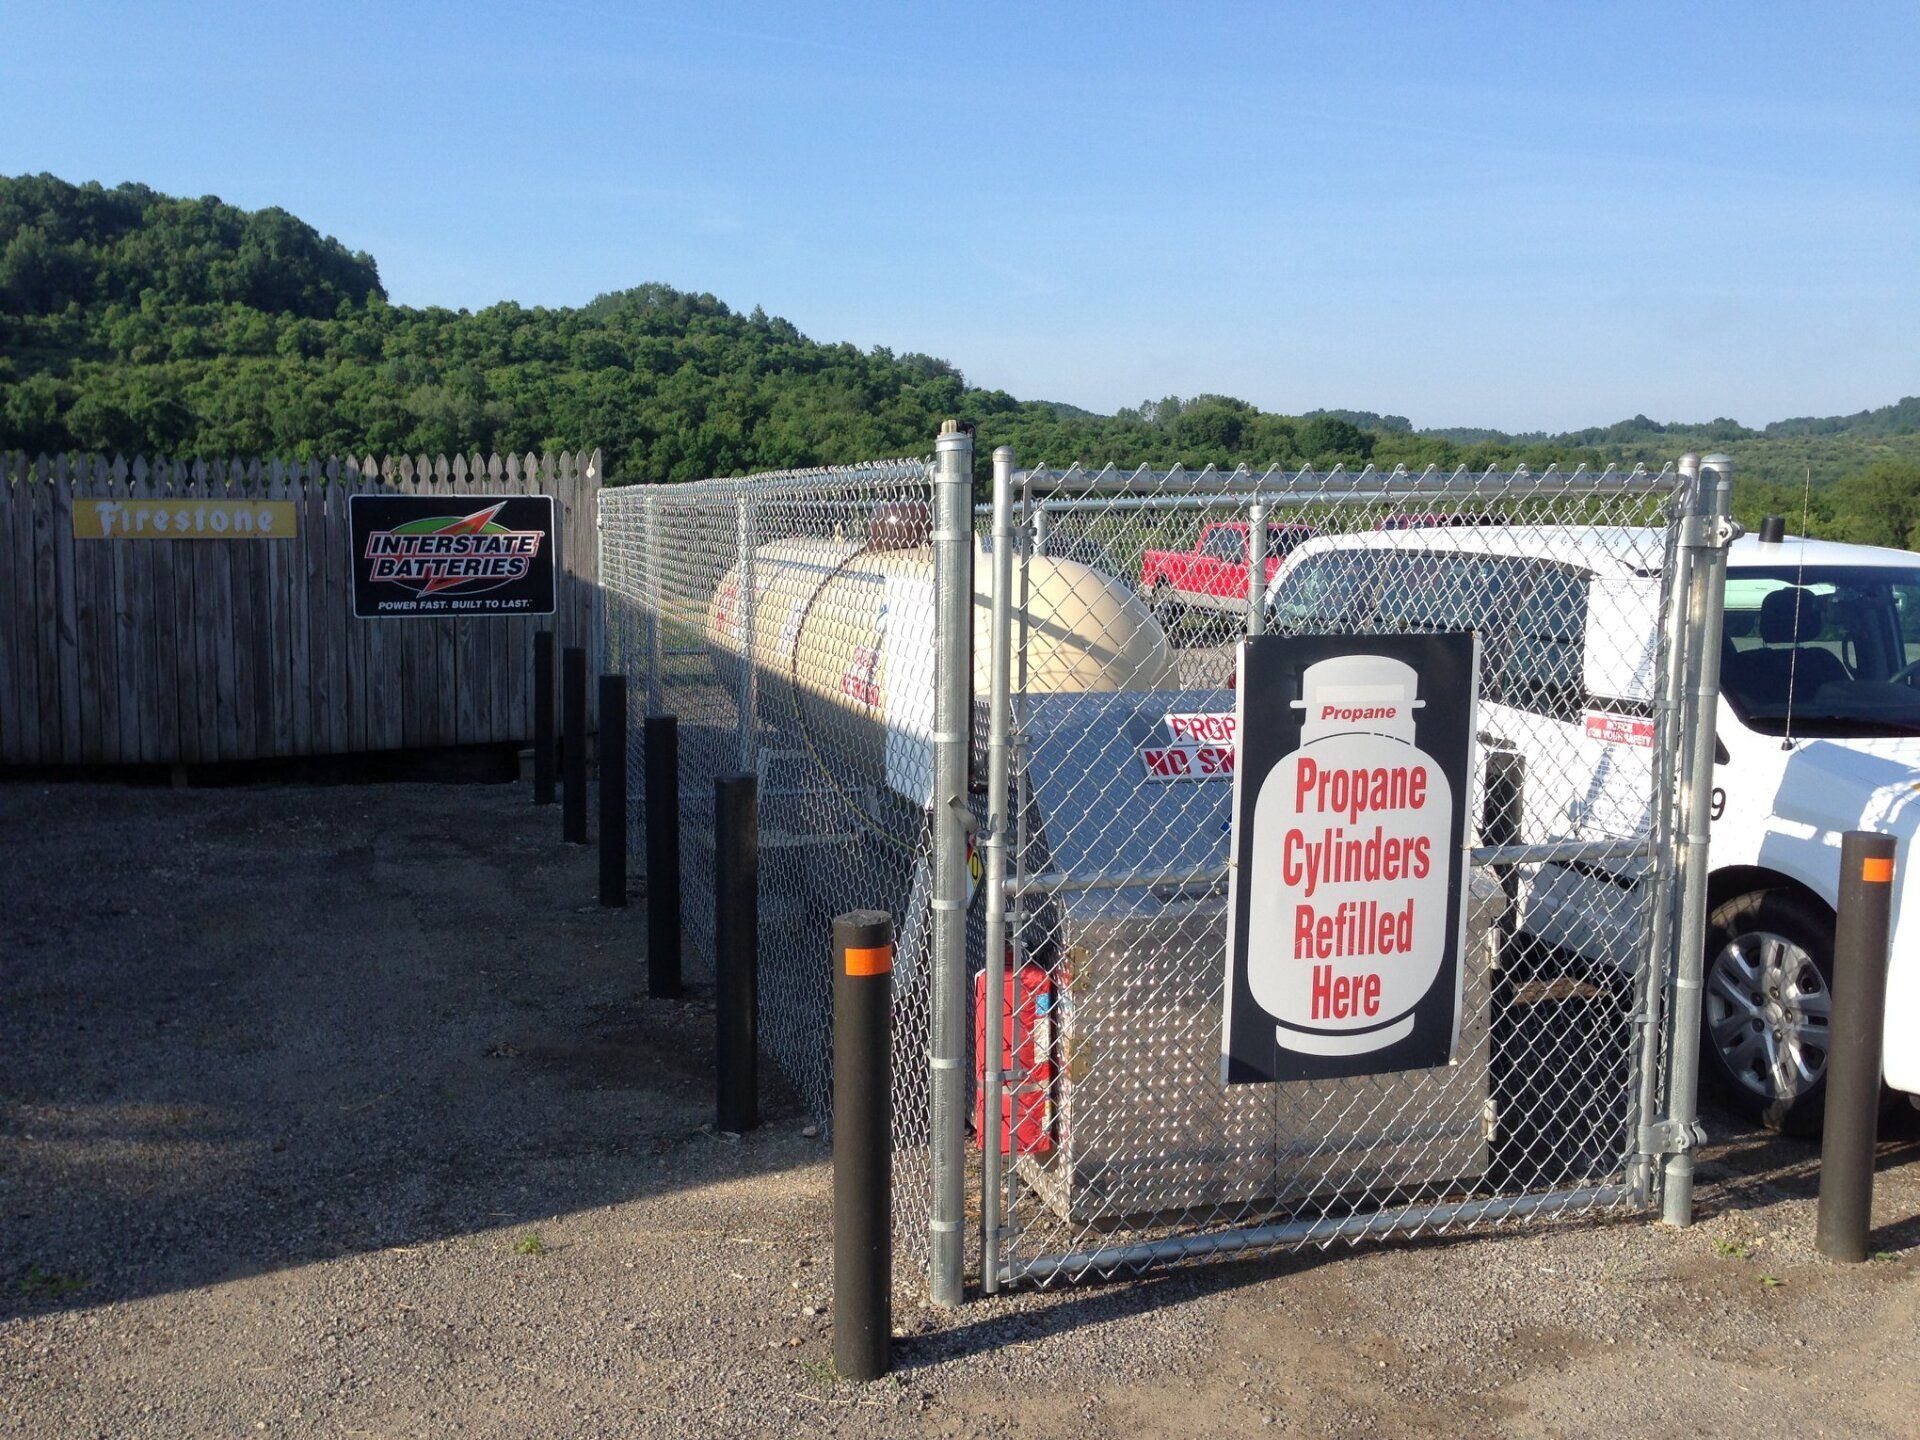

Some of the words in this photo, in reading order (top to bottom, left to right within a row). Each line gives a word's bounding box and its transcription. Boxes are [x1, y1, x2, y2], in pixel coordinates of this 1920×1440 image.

[95, 502, 274, 537] Firestone
[370, 534, 536, 555] INTERSTATE
[376, 556, 527, 577] BATTERIES
[378, 601, 417, 610] POWER
[419, 601, 449, 610] FAST.
[452, 600, 485, 609] BUILT
[486, 600, 499, 608] TO
[501, 599, 530, 608] LAST.
[1320, 705, 1397, 722] Propane
[1144, 749, 1192, 776] NO
[1295, 757, 1427, 825] Propane
[1282, 826, 1431, 898] Cylinders
[1294, 898, 1415, 960] Refilled
[1311, 965, 1382, 1020] Here
